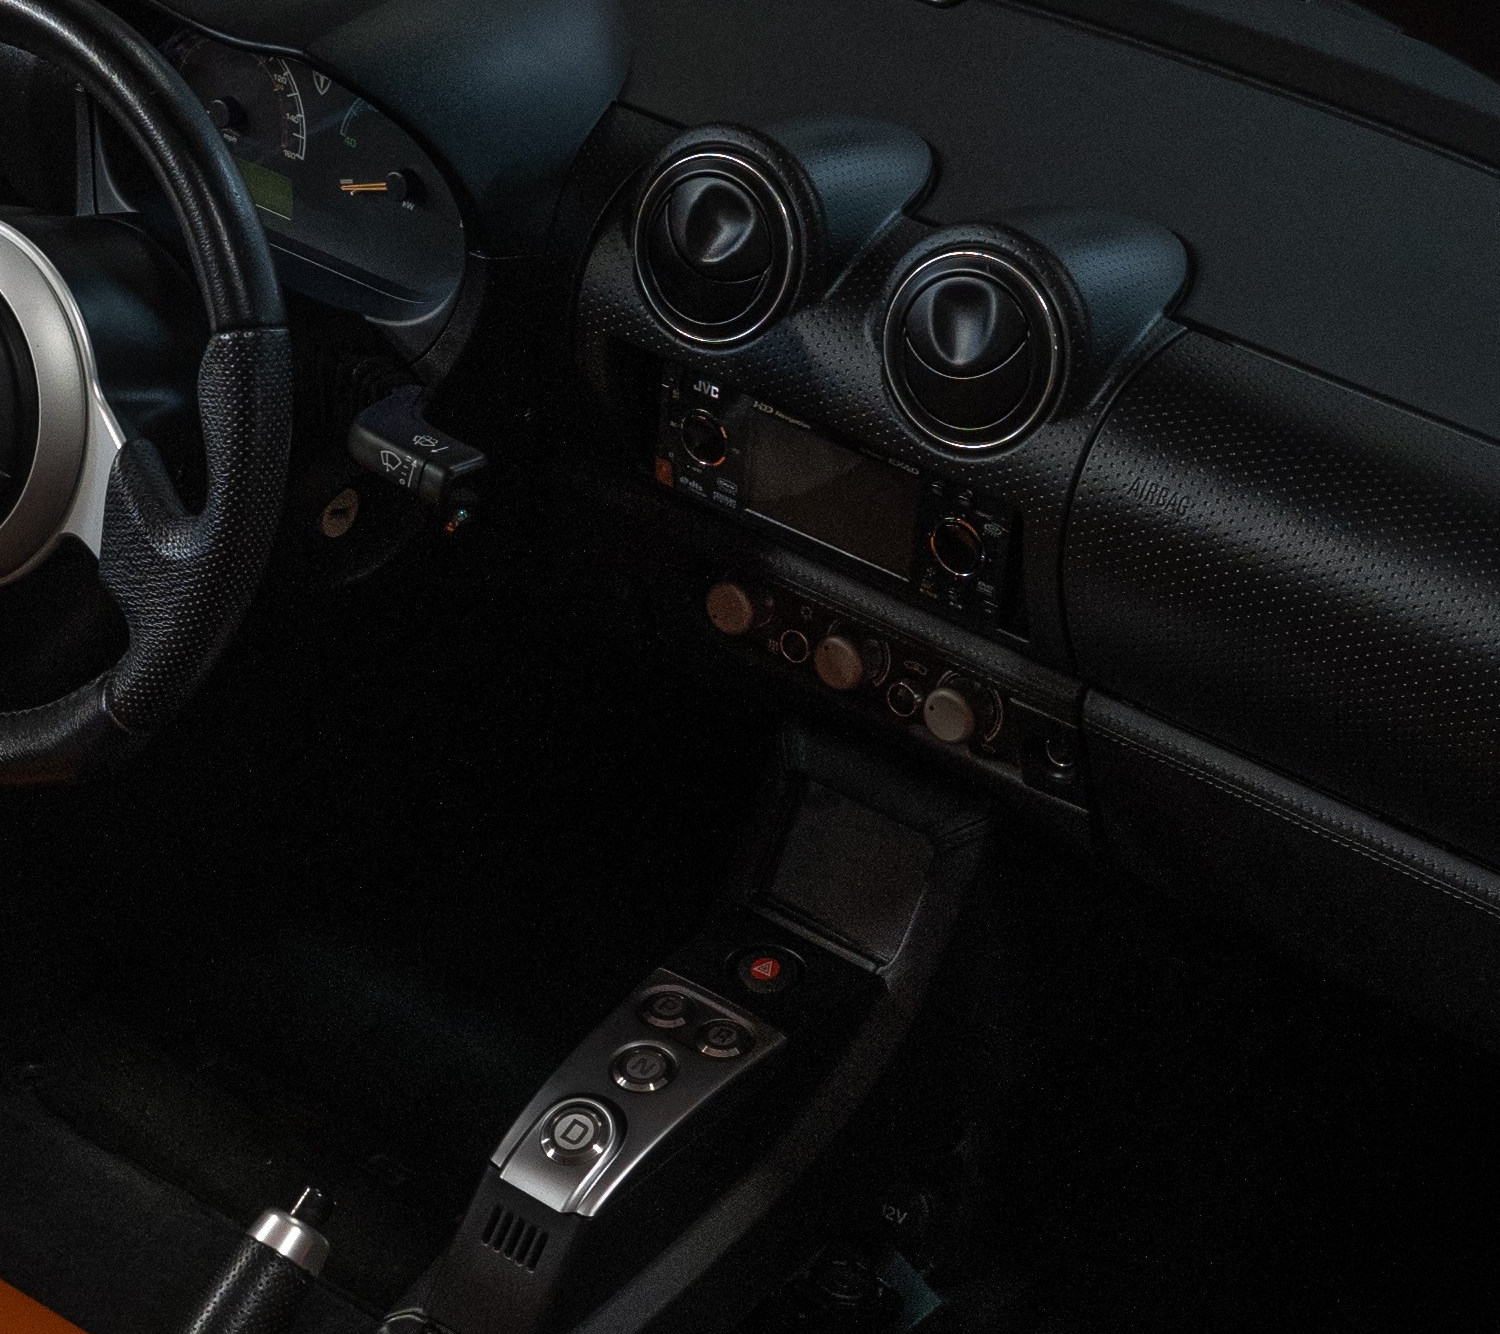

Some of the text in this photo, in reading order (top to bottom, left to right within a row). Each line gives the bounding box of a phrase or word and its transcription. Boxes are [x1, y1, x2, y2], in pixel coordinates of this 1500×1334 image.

[693, 380, 720, 399] JVC
[1126, 476, 1191, 516] AIRBAG
[712, 1027, 734, 1043] R
[630, 1056, 657, 1075] N
[560, 1118, 589, 1145] D
